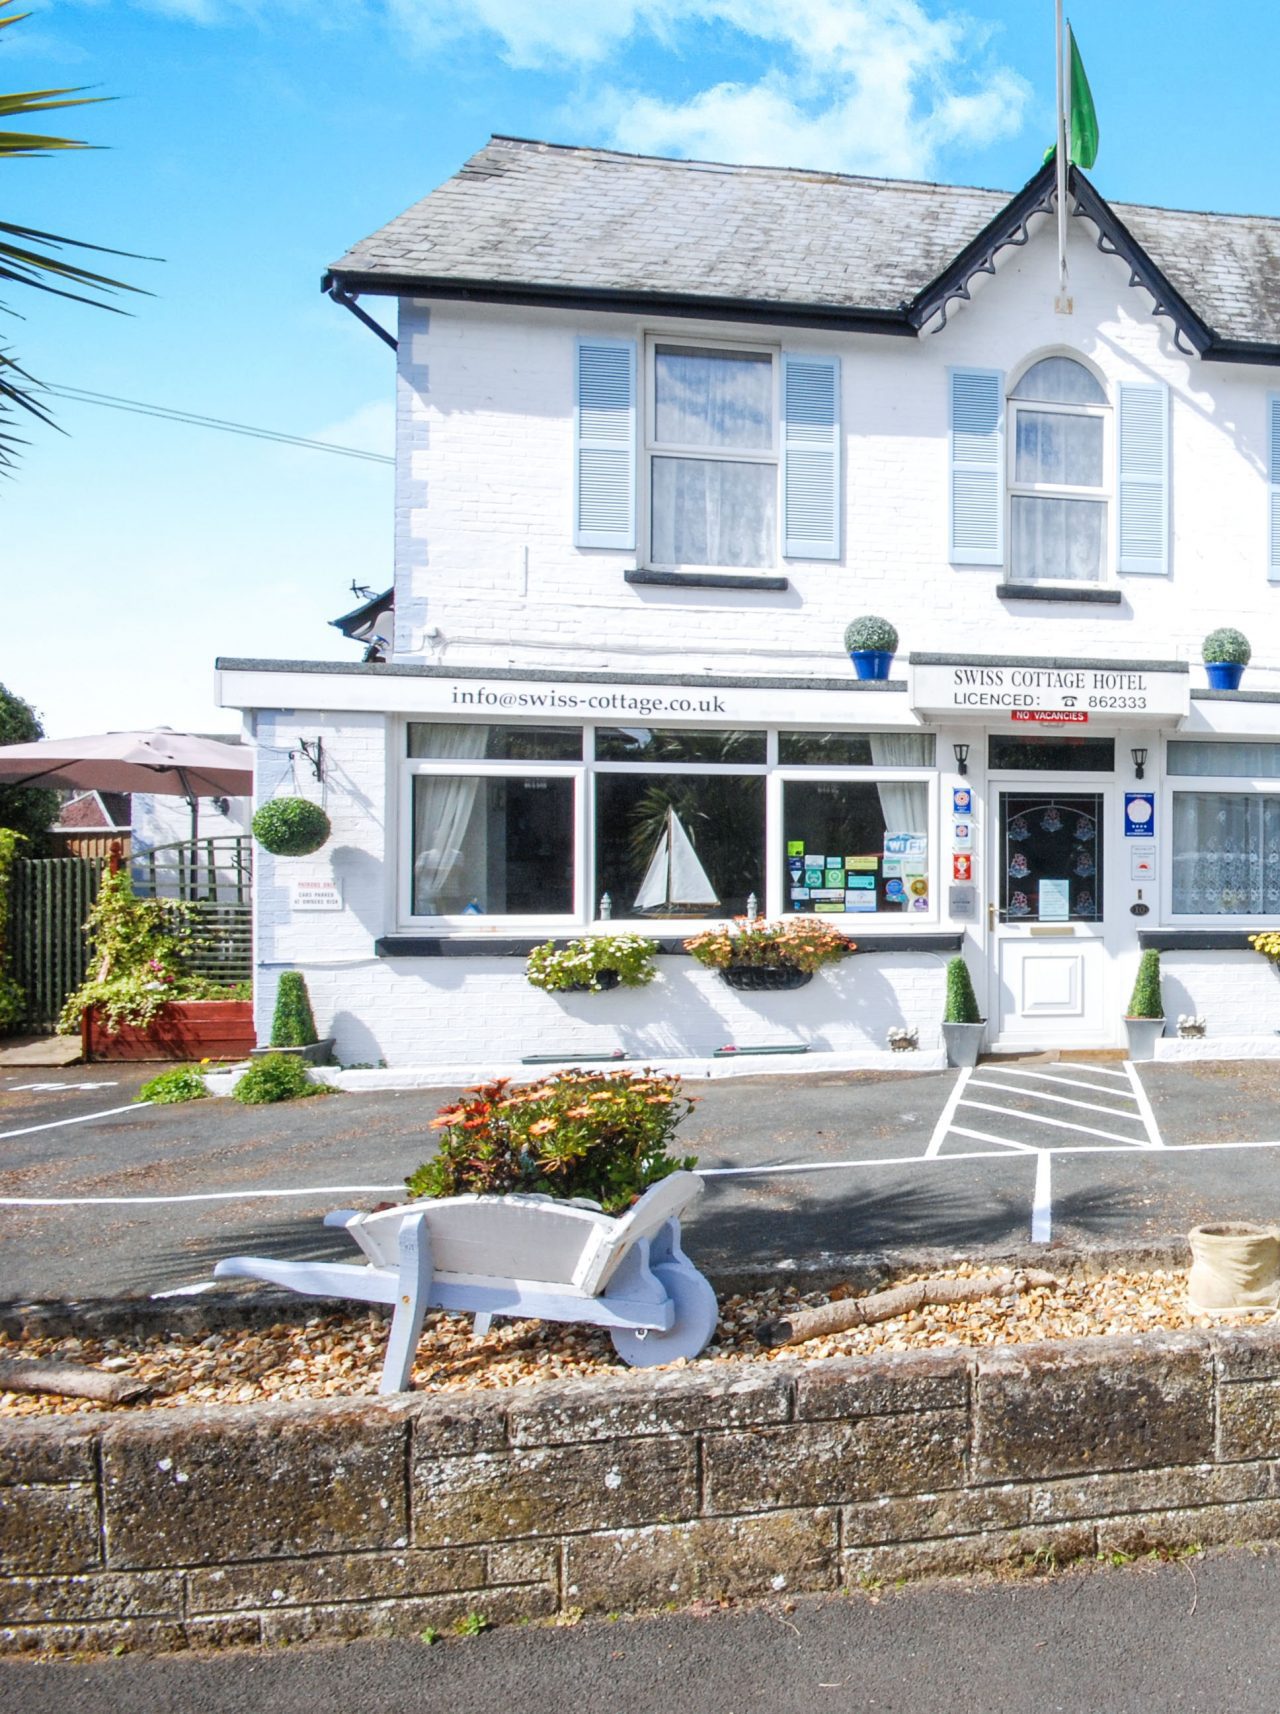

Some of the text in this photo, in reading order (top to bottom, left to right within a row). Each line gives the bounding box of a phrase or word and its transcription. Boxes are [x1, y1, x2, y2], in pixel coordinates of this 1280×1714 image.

[954, 669, 1147, 690] SWISS COTTAGE HOTEL
[452, 686, 726, 715] info@swiss-cottage.co.uk
[954, 692, 1147, 709] LICENCED: 862333
[1016, 711, 1084, 721] NO VACANCIES
